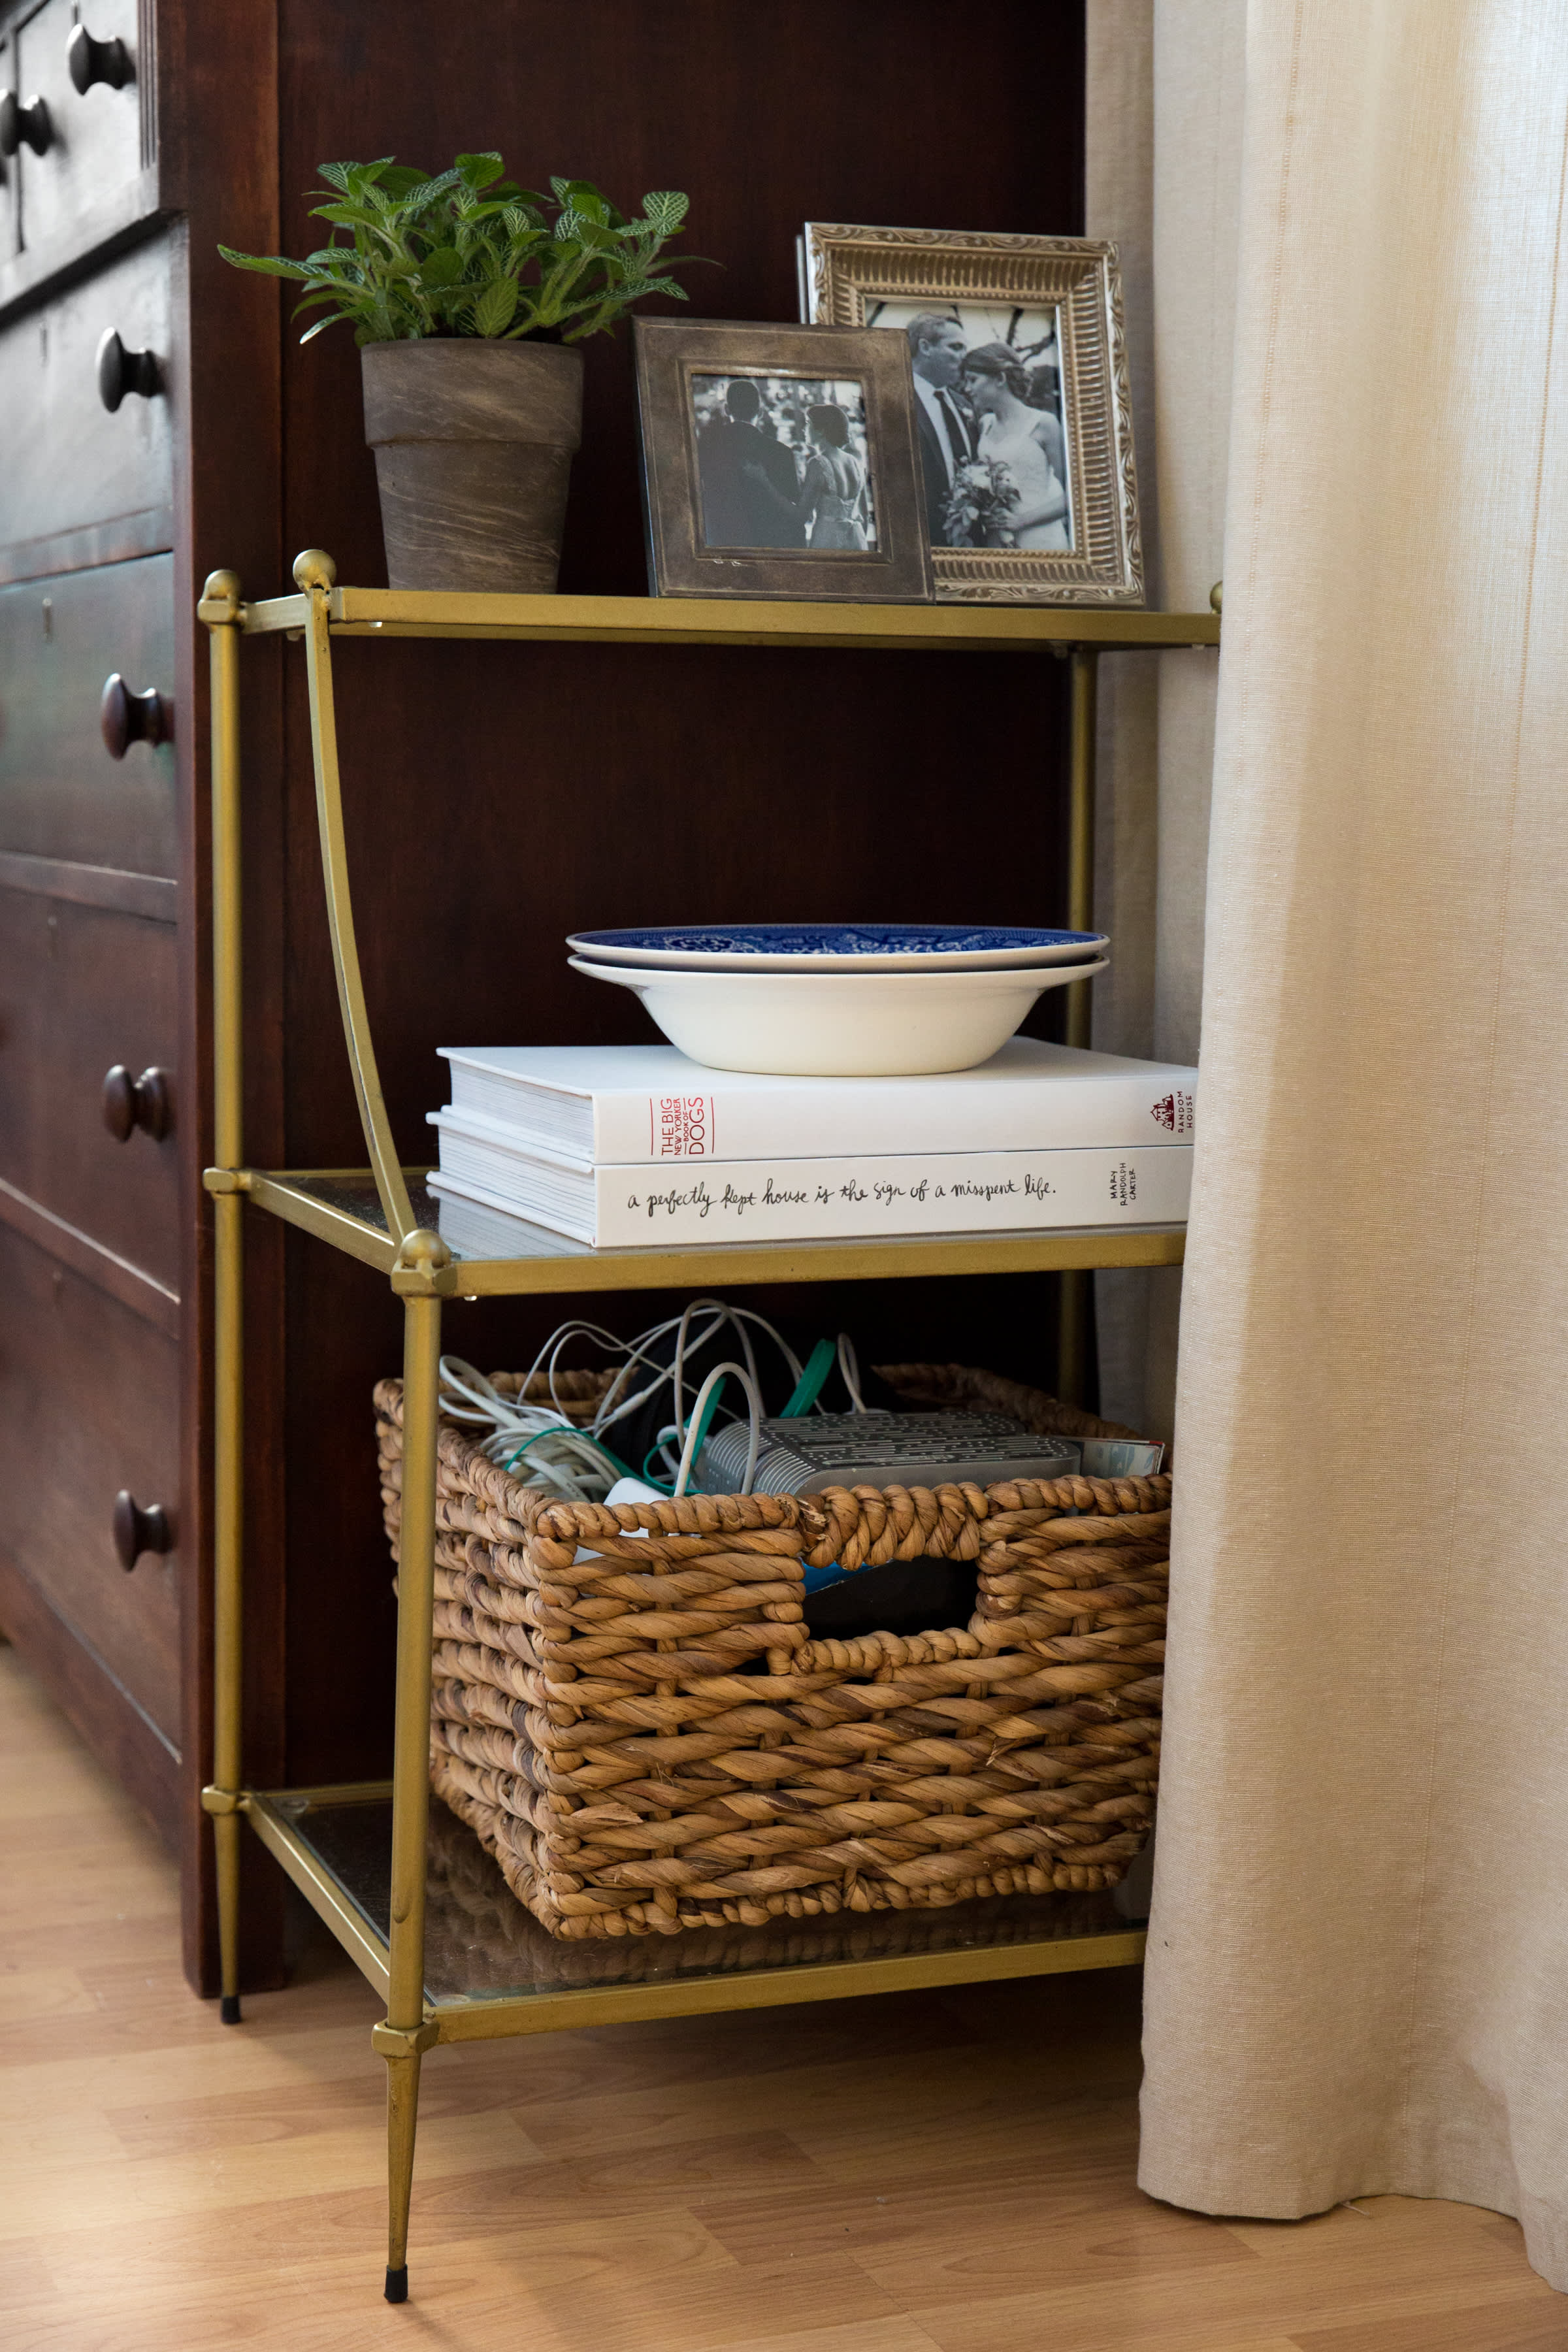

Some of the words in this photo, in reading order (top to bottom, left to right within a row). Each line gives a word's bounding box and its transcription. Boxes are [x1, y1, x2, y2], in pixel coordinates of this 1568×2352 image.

[660, 1098, 674, 1124] BIG
[673, 1098, 681, 1132] YORKER
[683, 1111, 689, 1120] OF
[687, 1096, 705, 1155] DOGS
[661, 1127, 674, 1156] THE
[674, 1135, 682, 1156] NEW
[628, 1195, 640, 1209] a
[647, 1181, 717, 1218] perfectly
[721, 1184, 757, 1215] kept
[762, 1178, 809, 1205] house
[814, 1185, 835, 1204] is
[840, 1179, 868, 1201] the
[874, 1181, 906, 1206] sign
[910, 1179, 930, 1201] of
[935, 1186, 946, 1198] a
[951, 1179, 1021, 1201] misspent
[1024, 1174, 1056, 1201] life.
[1119, 1162, 1128, 1206] RANDOLPH
